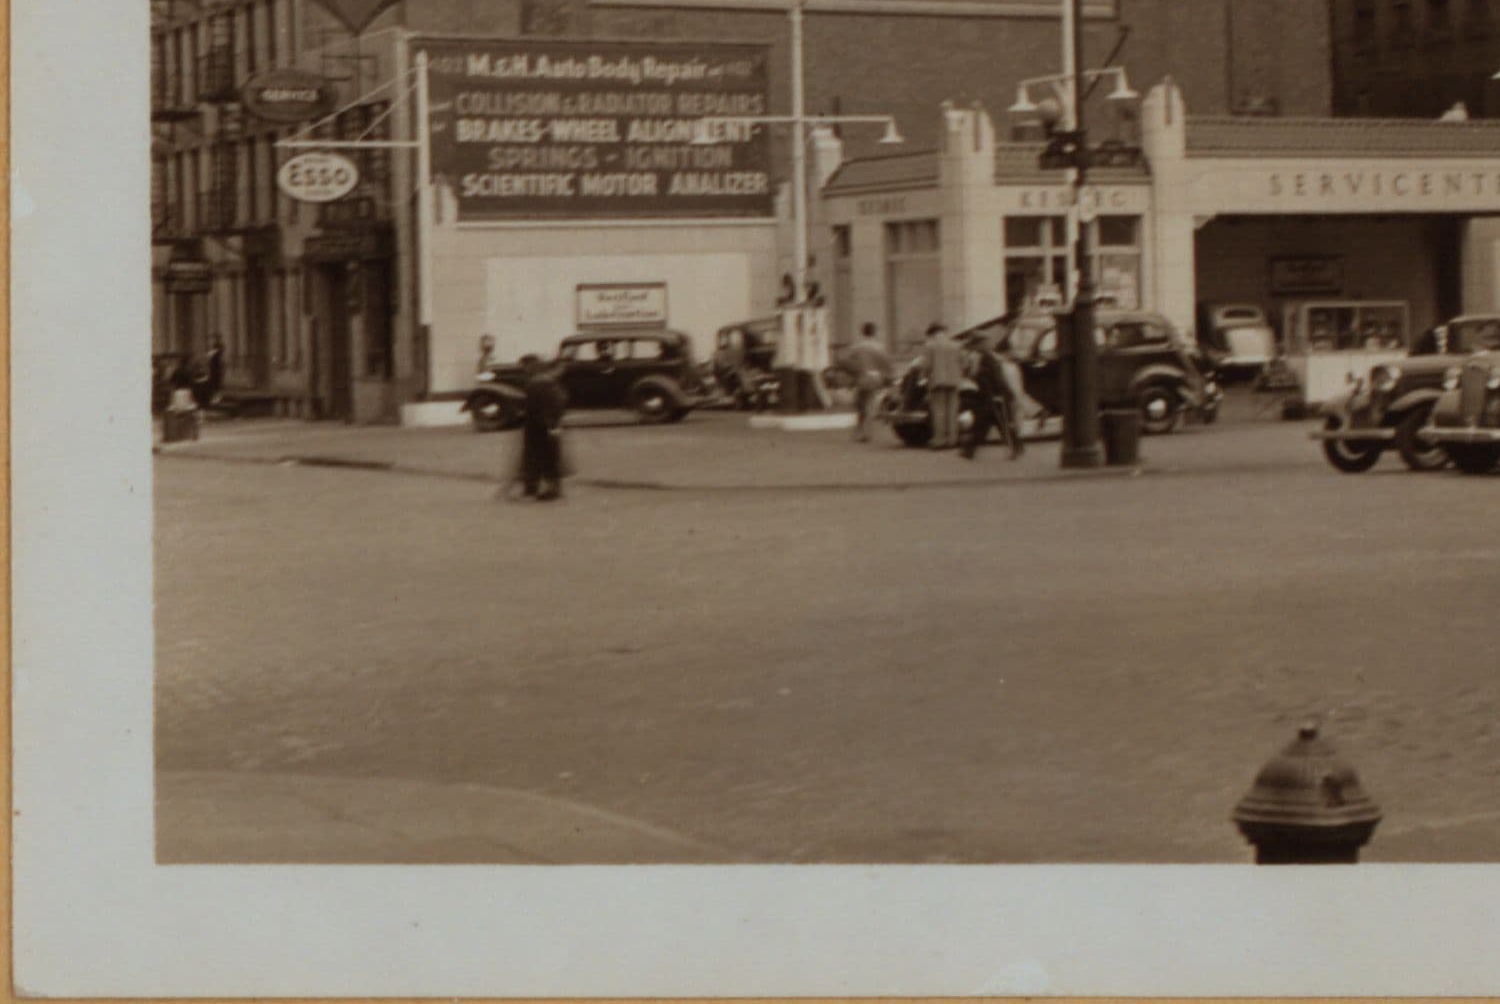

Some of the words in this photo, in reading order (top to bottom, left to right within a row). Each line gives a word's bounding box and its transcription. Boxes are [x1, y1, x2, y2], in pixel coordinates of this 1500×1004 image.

[456, 92, 560, 115] COLLISION
[578, 93, 673, 115] RADIATOR
[677, 94, 763, 116] REPAIRS
[487, 147, 599, 171] SPRINGS
[625, 147, 734, 170] IGNITION
[462, 172, 576, 197] SCIENTIFIC
[580, 172, 657, 197] MOTOR
